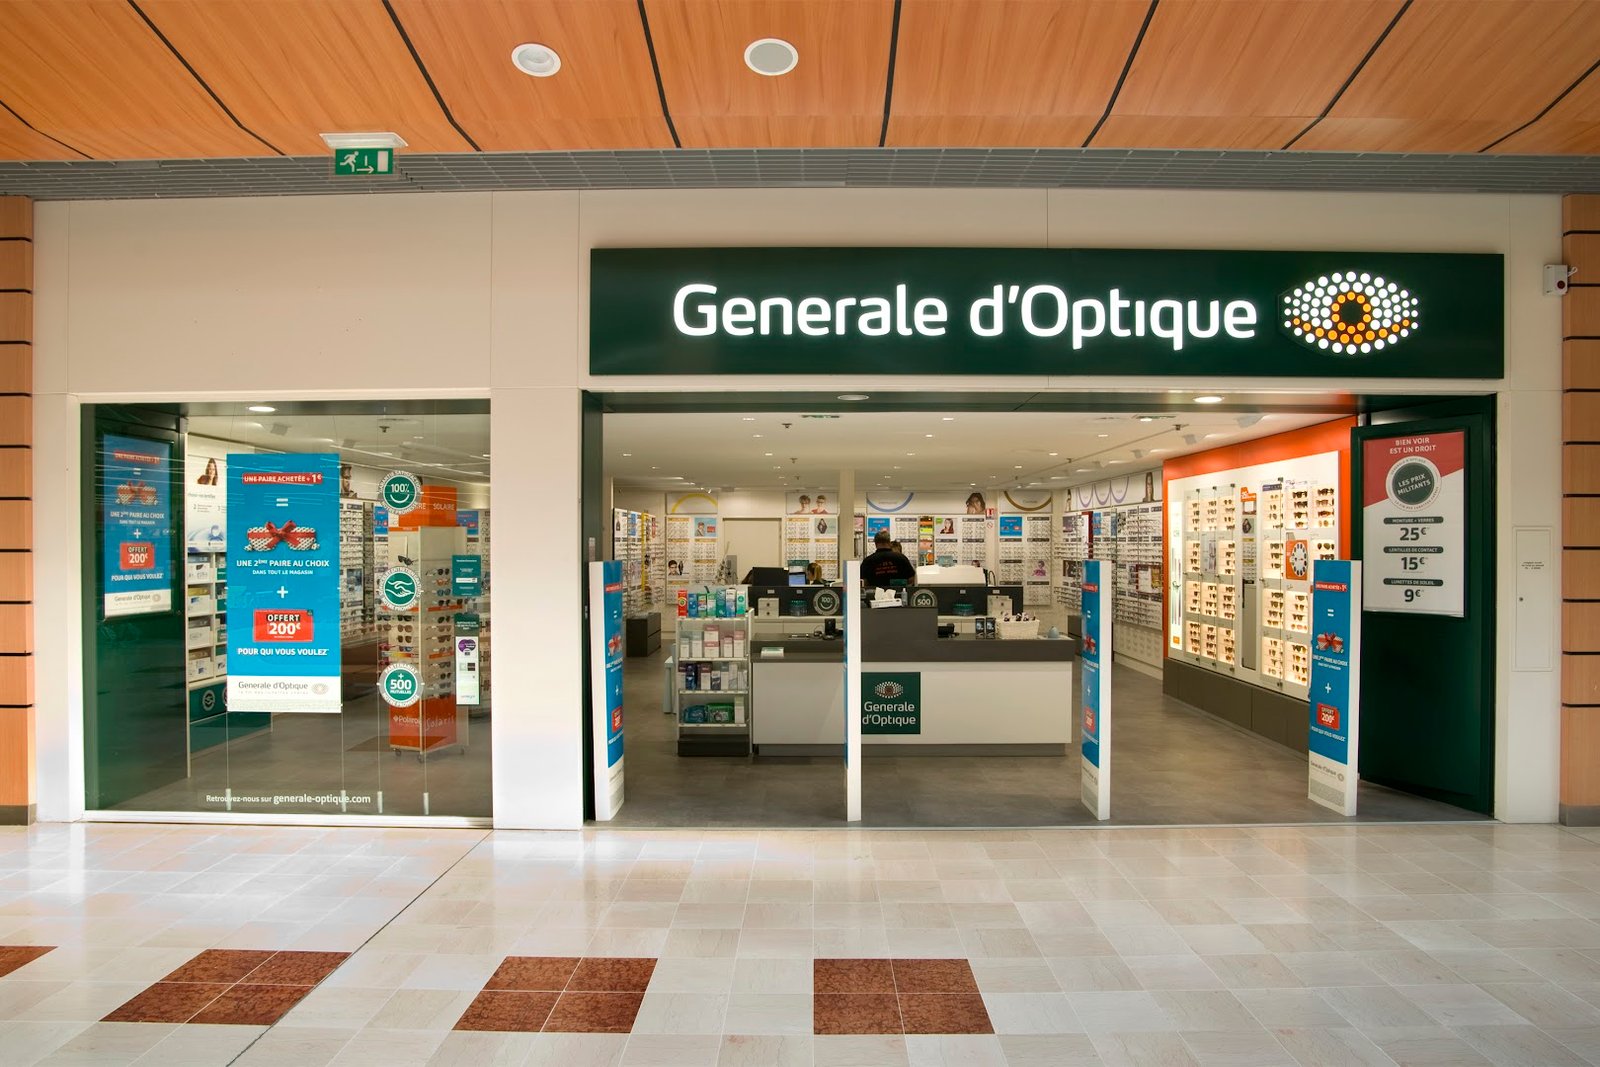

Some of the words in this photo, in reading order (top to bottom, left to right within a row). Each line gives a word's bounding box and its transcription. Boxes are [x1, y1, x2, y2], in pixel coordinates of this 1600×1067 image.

[673, 283, 948, 337] Generale
[970, 283, 1257, 351] d'Optique
[1412, 437, 1430, 445] VOIR
[1397, 479, 1409, 487] LES
[1410, 473, 1426, 484] PRIX
[390, 483, 410, 493] 100%
[1397, 479, 1431, 495] MILITANTS
[1400, 527, 1427, 541] 25€
[1401, 556, 1425, 570] 15€
[1404, 589, 1421, 602] 9€
[267, 614, 300, 622] OFFERT
[268, 622, 301, 635] 200€
[237, 648, 259, 656] POUR
[260, 648, 273, 656] QUI
[275, 648, 296, 656] VOUS
[273, 682, 308, 690] d'Optique
[390, 679, 412, 690] 500
[863, 701, 915, 712] Generale
[862, 714, 916, 727] d'Optique
[273, 793, 371, 805] generale-optique.com
